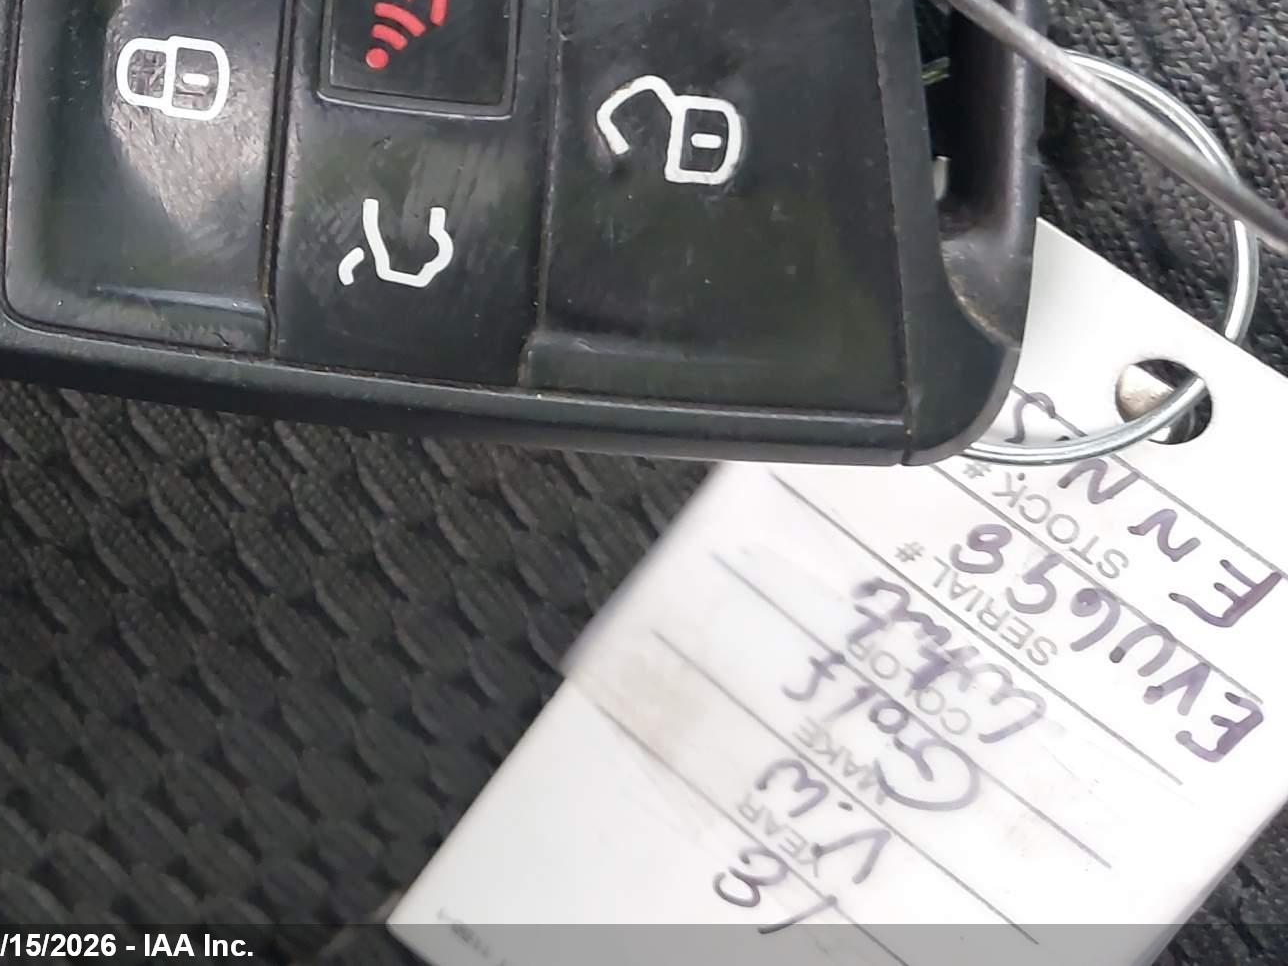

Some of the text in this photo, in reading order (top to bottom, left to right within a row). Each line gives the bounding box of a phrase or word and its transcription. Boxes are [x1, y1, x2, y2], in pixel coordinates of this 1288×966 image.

[992, 471, 1130, 579] STOCK
[894, 542, 1059, 666] SERIAL #
[782, 651, 980, 811] Golf
[846, 632, 972, 736] COLOR
[791, 715, 895, 806] MAKE
[735, 796, 823, 877] YEAR
